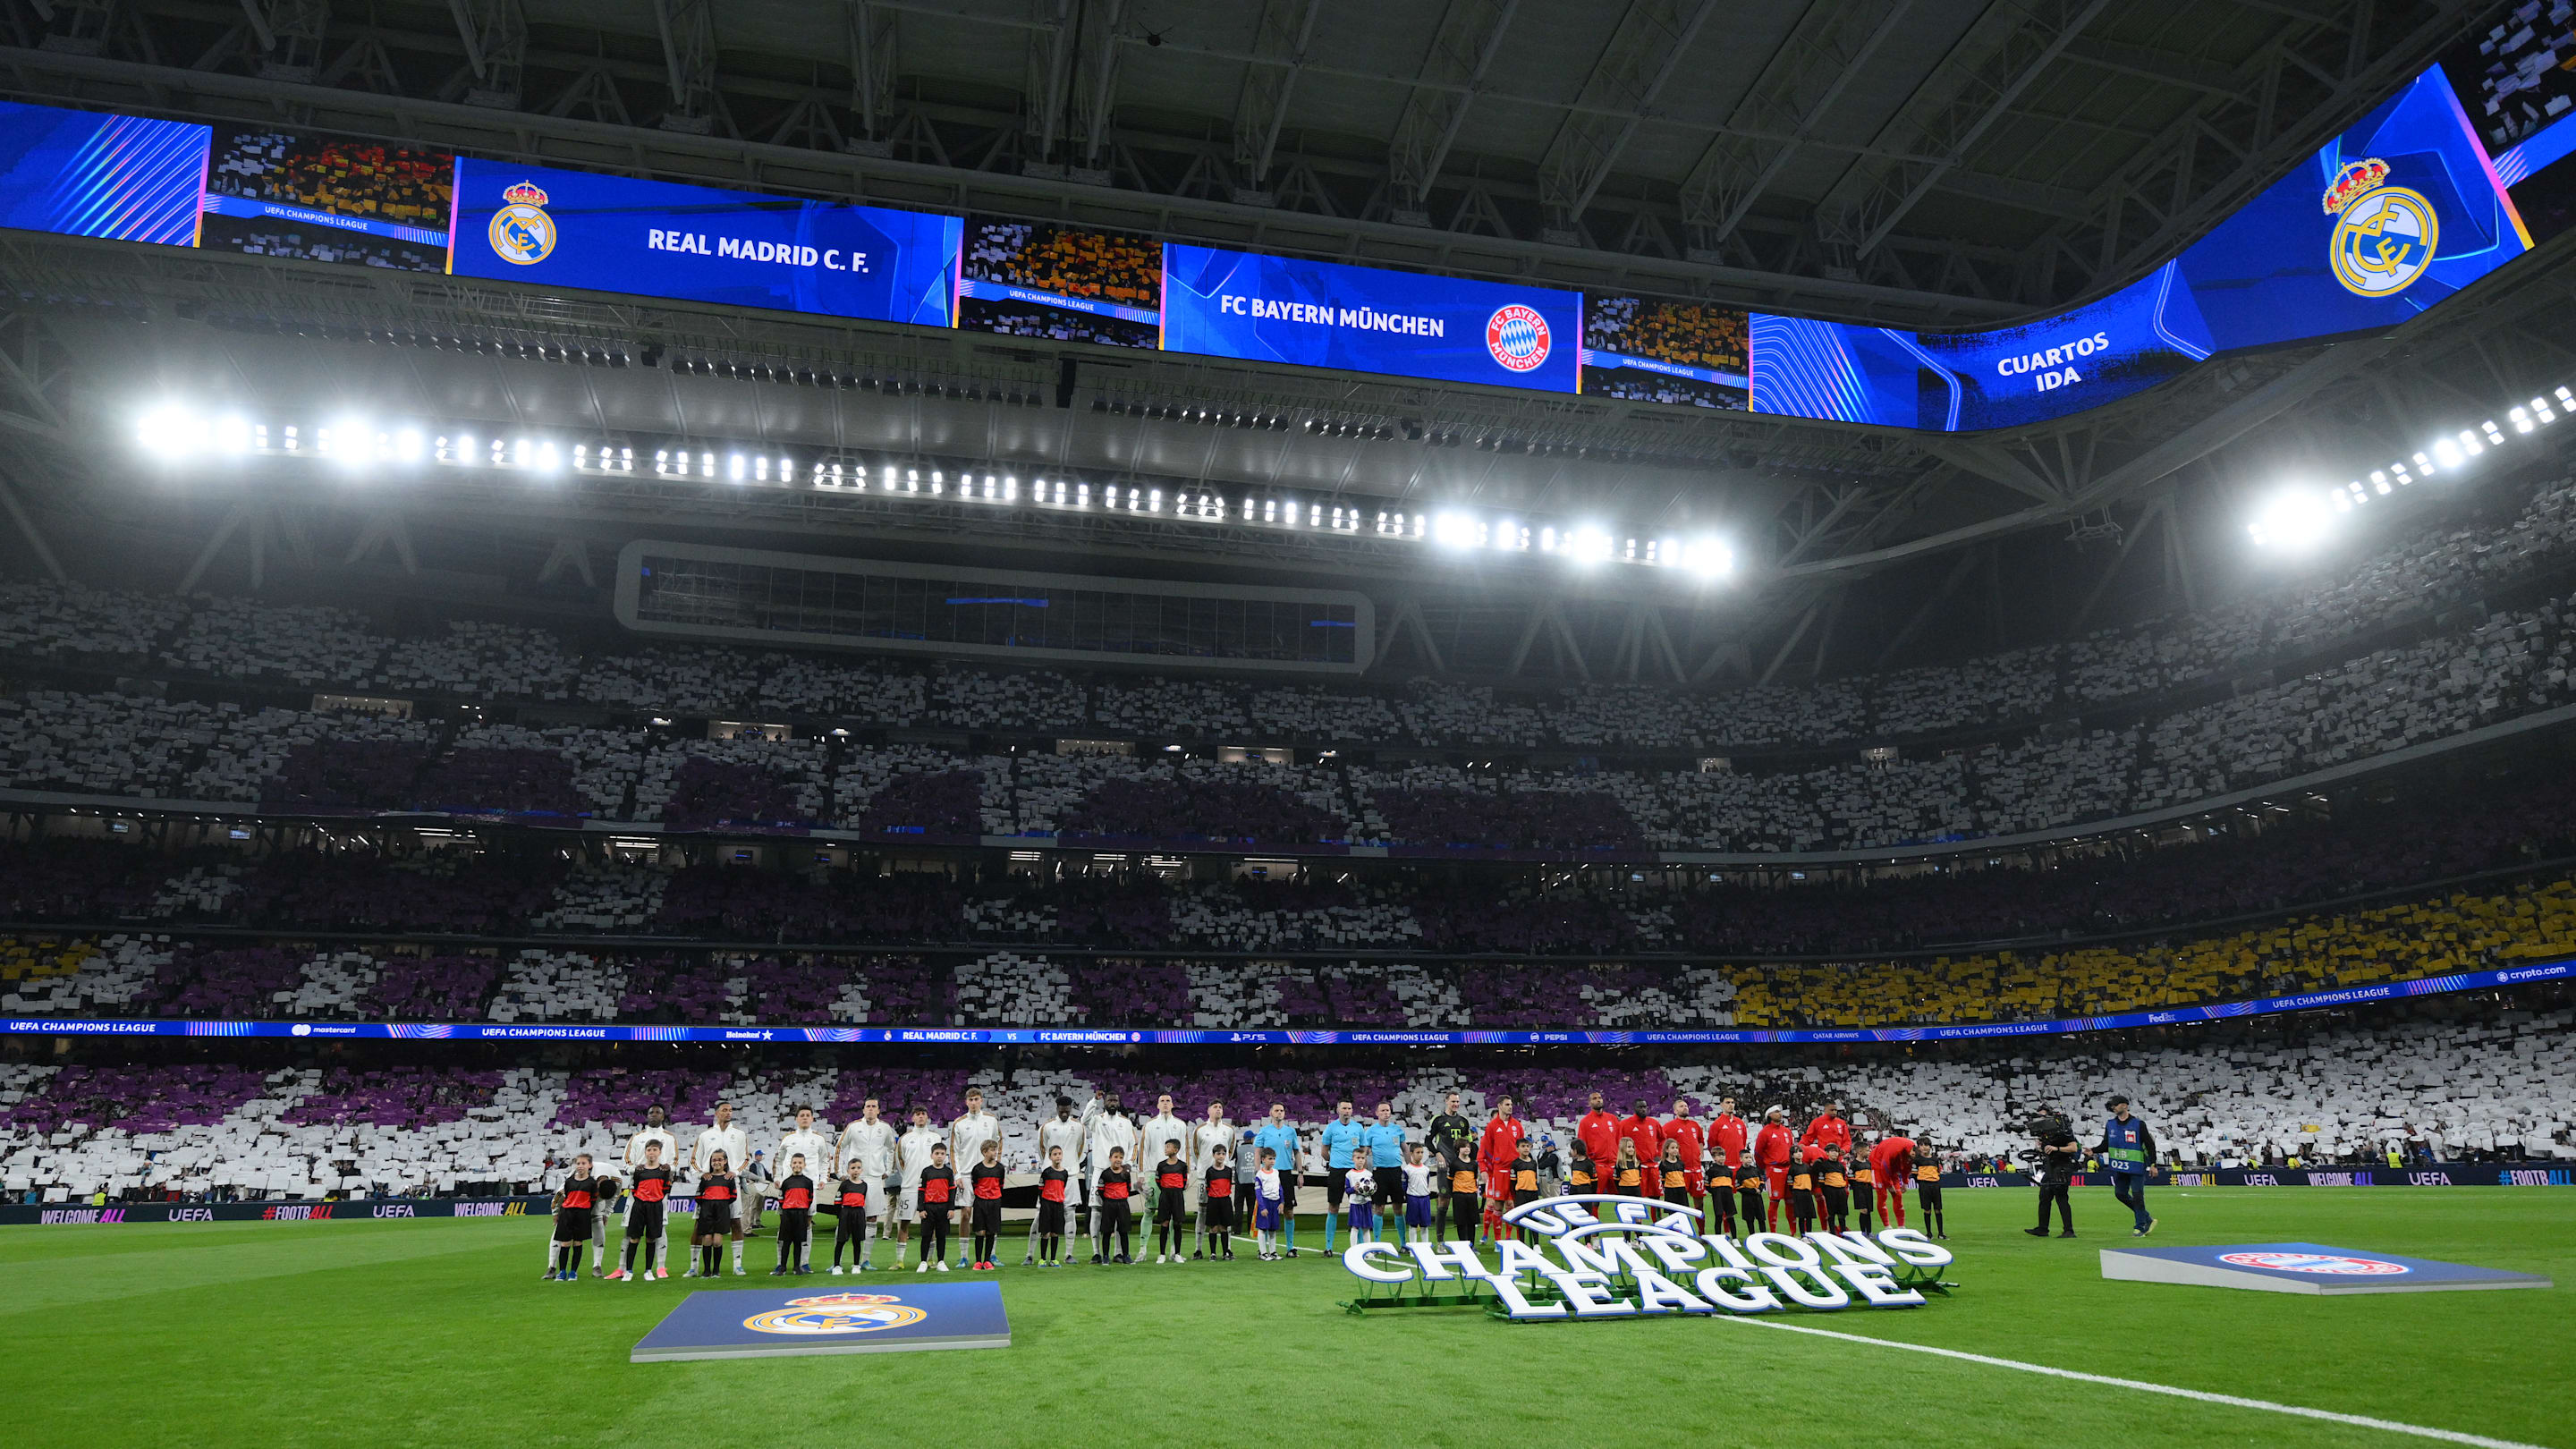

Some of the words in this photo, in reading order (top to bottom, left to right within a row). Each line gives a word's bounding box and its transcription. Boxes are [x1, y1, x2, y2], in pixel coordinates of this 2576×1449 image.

[265, 206, 284, 216] UEFA
[286, 209, 335, 225] CHAMPIONS
[335, 218, 368, 230] LEAGUE
[648, 228, 711, 255] REAL
[717, 237, 818, 267] MADRID
[823, 249, 845, 270] C.
[852, 252, 869, 273] F.
[1009, 289, 1026, 299] UEFA
[1027, 292, 1066, 307] CHAMPIONS
[1068, 301, 1094, 311] LEAGUE
[1221, 294, 1246, 315] FC
[1252, 298, 1334, 326] BAYERN
[1339, 306, 1444, 337] MÜNCHEN
[1491, 315, 1504, 331] FC
[1504, 308, 1546, 336] BAYERN
[1997, 331, 2109, 376] CUARTOS
[1623, 358, 1637, 367] UEFA
[1638, 360, 1671, 372] CHAMPIONS
[1672, 367, 1694, 377] LEAGUE
[2036, 366, 2081, 392] IDA
[2510, 966, 2566, 979] crypto.com
[2272, 1000, 2295, 1009] UEFA
[2296, 992, 2351, 1006] CHAMPIONS
[2352, 987, 2390, 998] LEAGUE
[2148, 1013, 2175, 1023] FedEx
[10, 1021, 39, 1030] UEFA
[42, 1021, 110, 1031] CHAMPIONS
[112, 1022, 156, 1032] LEAGUE
[313, 1026, 356, 1034] mastercard
[482, 1028, 506, 1037] UEFA
[509, 1028, 566, 1037] CHAMPIONS
[568, 1029, 606, 1038] LEAGUE
[1939, 1029, 1961, 1037] UEFA
[1962, 1026, 2013, 1036] CHAMPIONS
[2014, 1024, 2048, 1033] LEAGUE
[725, 1030, 760, 1038] Heineken
[902, 1031, 925, 1040] REAL
[926, 1031, 960, 1040] MADRID
[962, 1031, 970, 1040] C.
[970, 1031, 978, 1040] F.
[1040, 1032, 1051, 1041] FC
[1052, 1032, 1084, 1041] BAYERN
[1085, 1030, 1126, 1041] MÜNCHEN
[2114, 1150, 2127, 1158] HB
[2111, 1160, 2130, 1171] 023
[1967, 1176, 1998, 1187] UEFA
[2071, 1175, 2086, 1186] ALL
[2169, 1174, 2217, 1186] #FOOTBALL
[2243, 1174, 2279, 1186] UEFA
[2307, 1173, 2353, 1186] WELCOME
[2354, 1173, 2376, 1186] ALL
[2409, 1172, 2453, 1186] UEFA
[2498, 1170, 2575, 1186] #FOOTBALL
[41, 1209, 100, 1224] WELCOME
[98, 1208, 126, 1224] ALL
[168, 1208, 213, 1222] UEFA
[262, 1205, 334, 1220] #FOOTBALL
[373, 1205, 415, 1218] UEFA
[454, 1202, 504, 1217] WELCOME
[504, 1201, 528, 1216] ALL
[1518, 1201, 1698, 1237] UEFA
[1342, 1227, 1954, 1284] CHAMPIONS
[1485, 1262, 1928, 1318] LEAGUE
